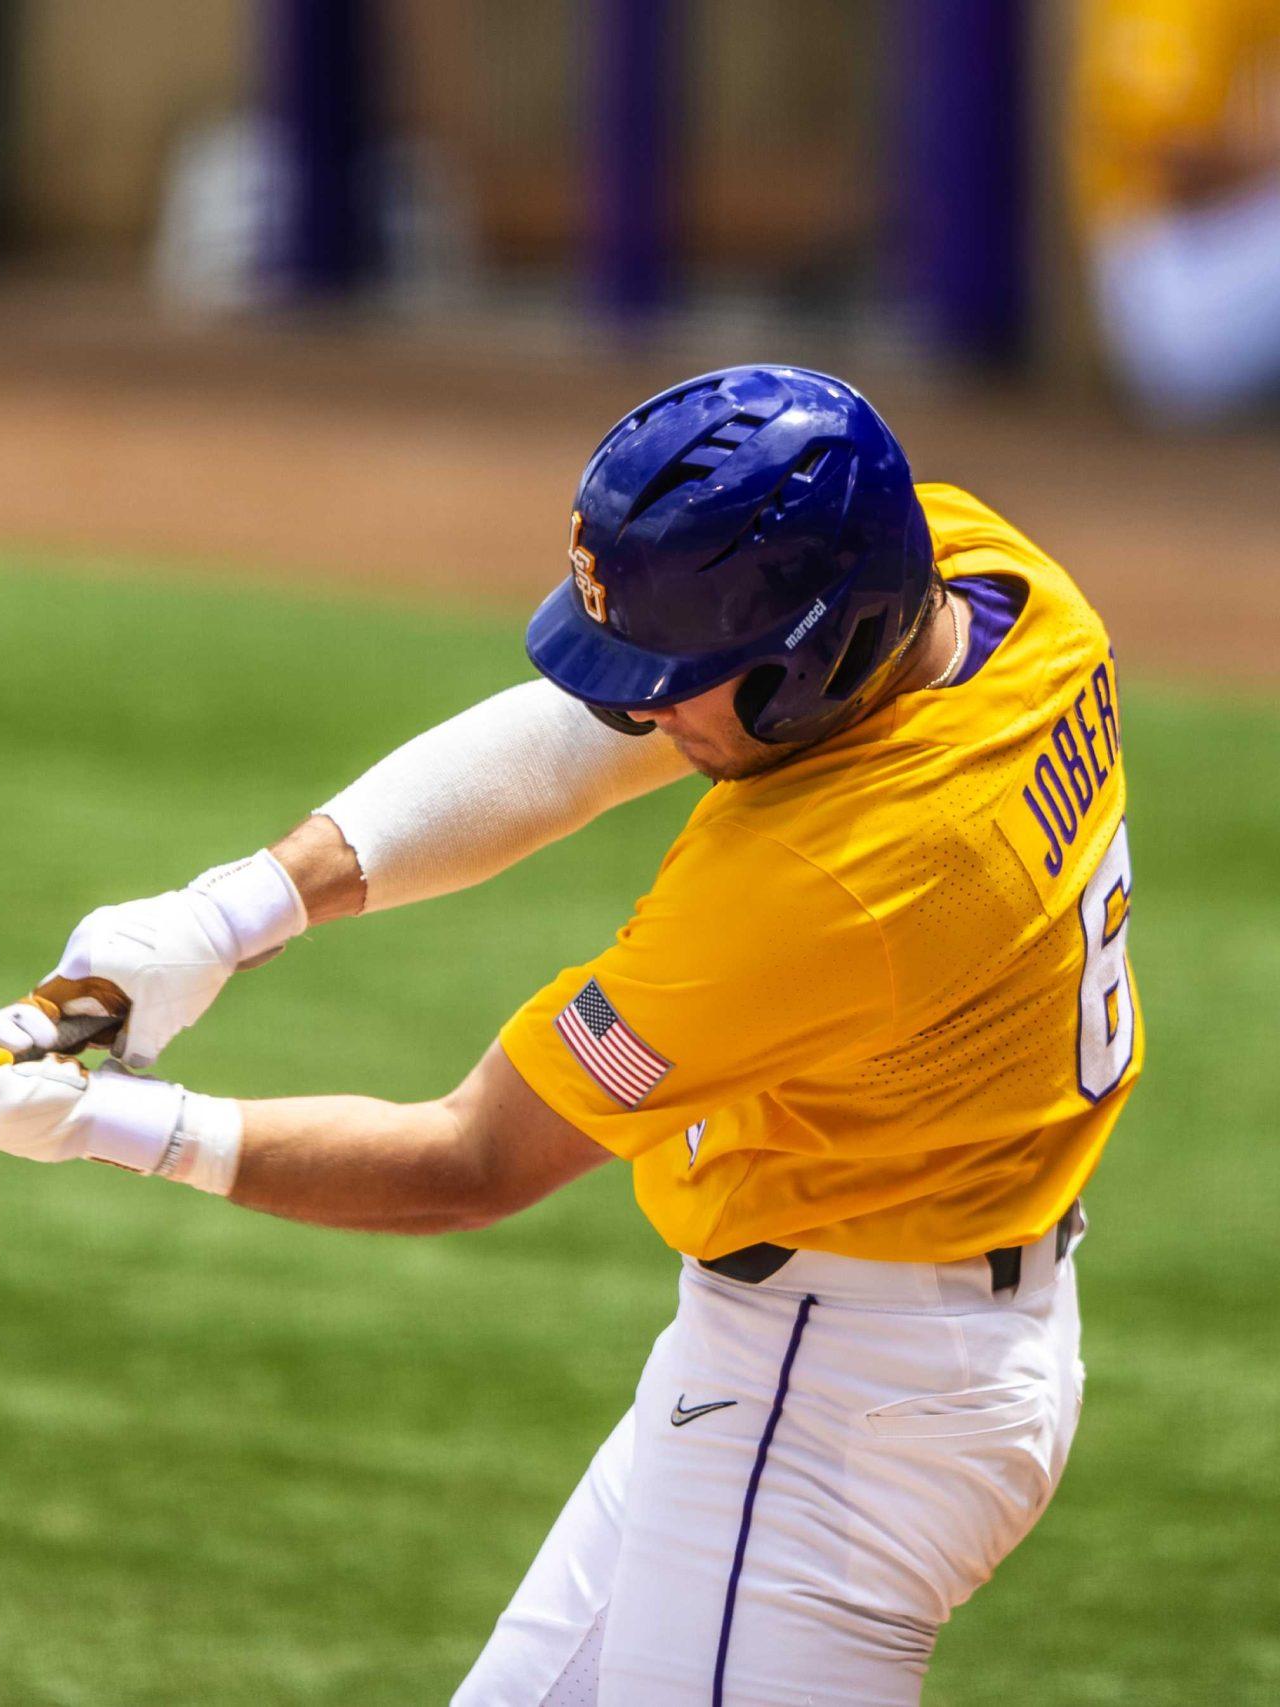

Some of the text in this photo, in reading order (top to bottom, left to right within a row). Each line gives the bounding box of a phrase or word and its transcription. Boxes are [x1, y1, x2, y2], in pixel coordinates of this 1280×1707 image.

[568, 511, 607, 624] LSU
[784, 598, 827, 650] marucci
[1022, 647, 1120, 878] JOBER
[1075, 814, 1135, 1105] 6
